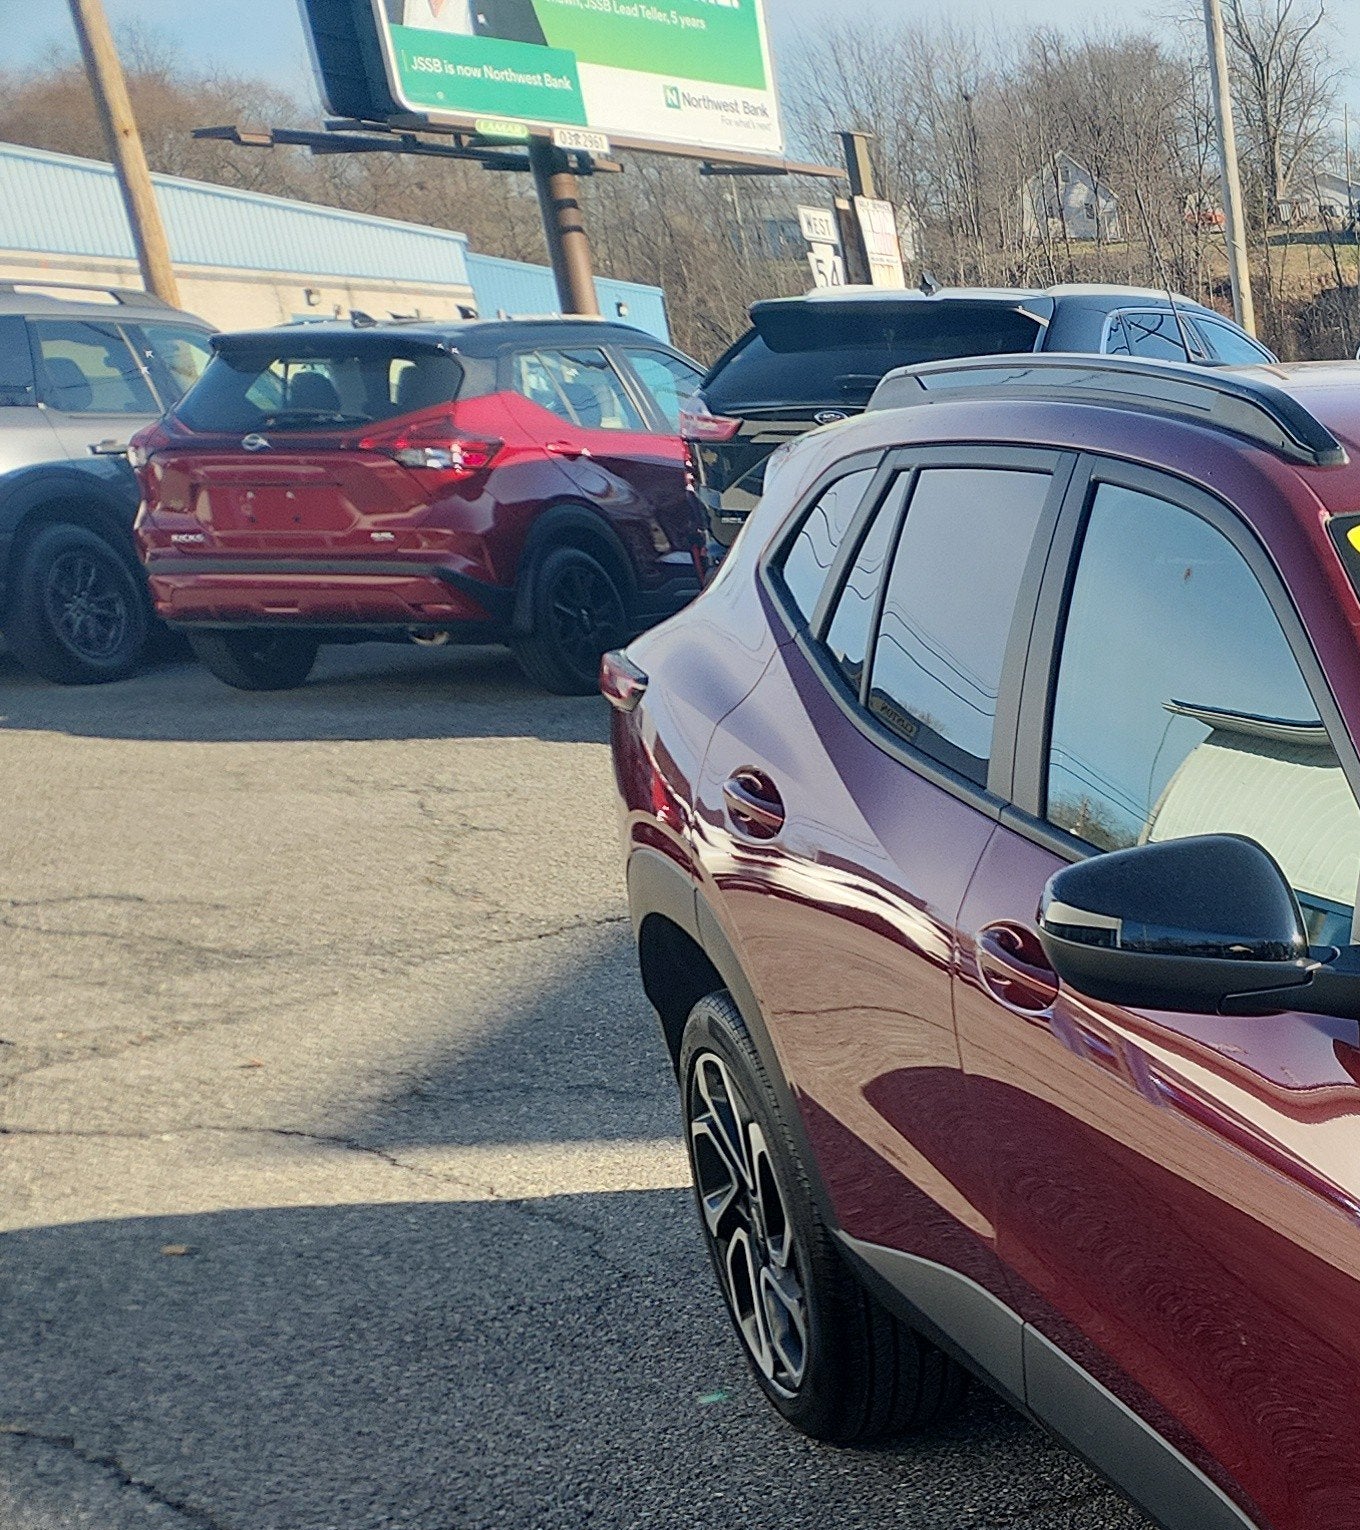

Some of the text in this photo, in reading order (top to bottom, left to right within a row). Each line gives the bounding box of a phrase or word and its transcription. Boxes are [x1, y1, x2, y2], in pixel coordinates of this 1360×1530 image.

[613, 0, 639, 17] Lead
[679, 15, 706, 29] years
[411, 56, 573, 91] JSSB is now Northwest Bank
[682, 92, 741, 115] Northwest
[742, 100, 769, 118] Bank
[803, 213, 832, 236] WEST
[815, 258, 842, 288] 54
